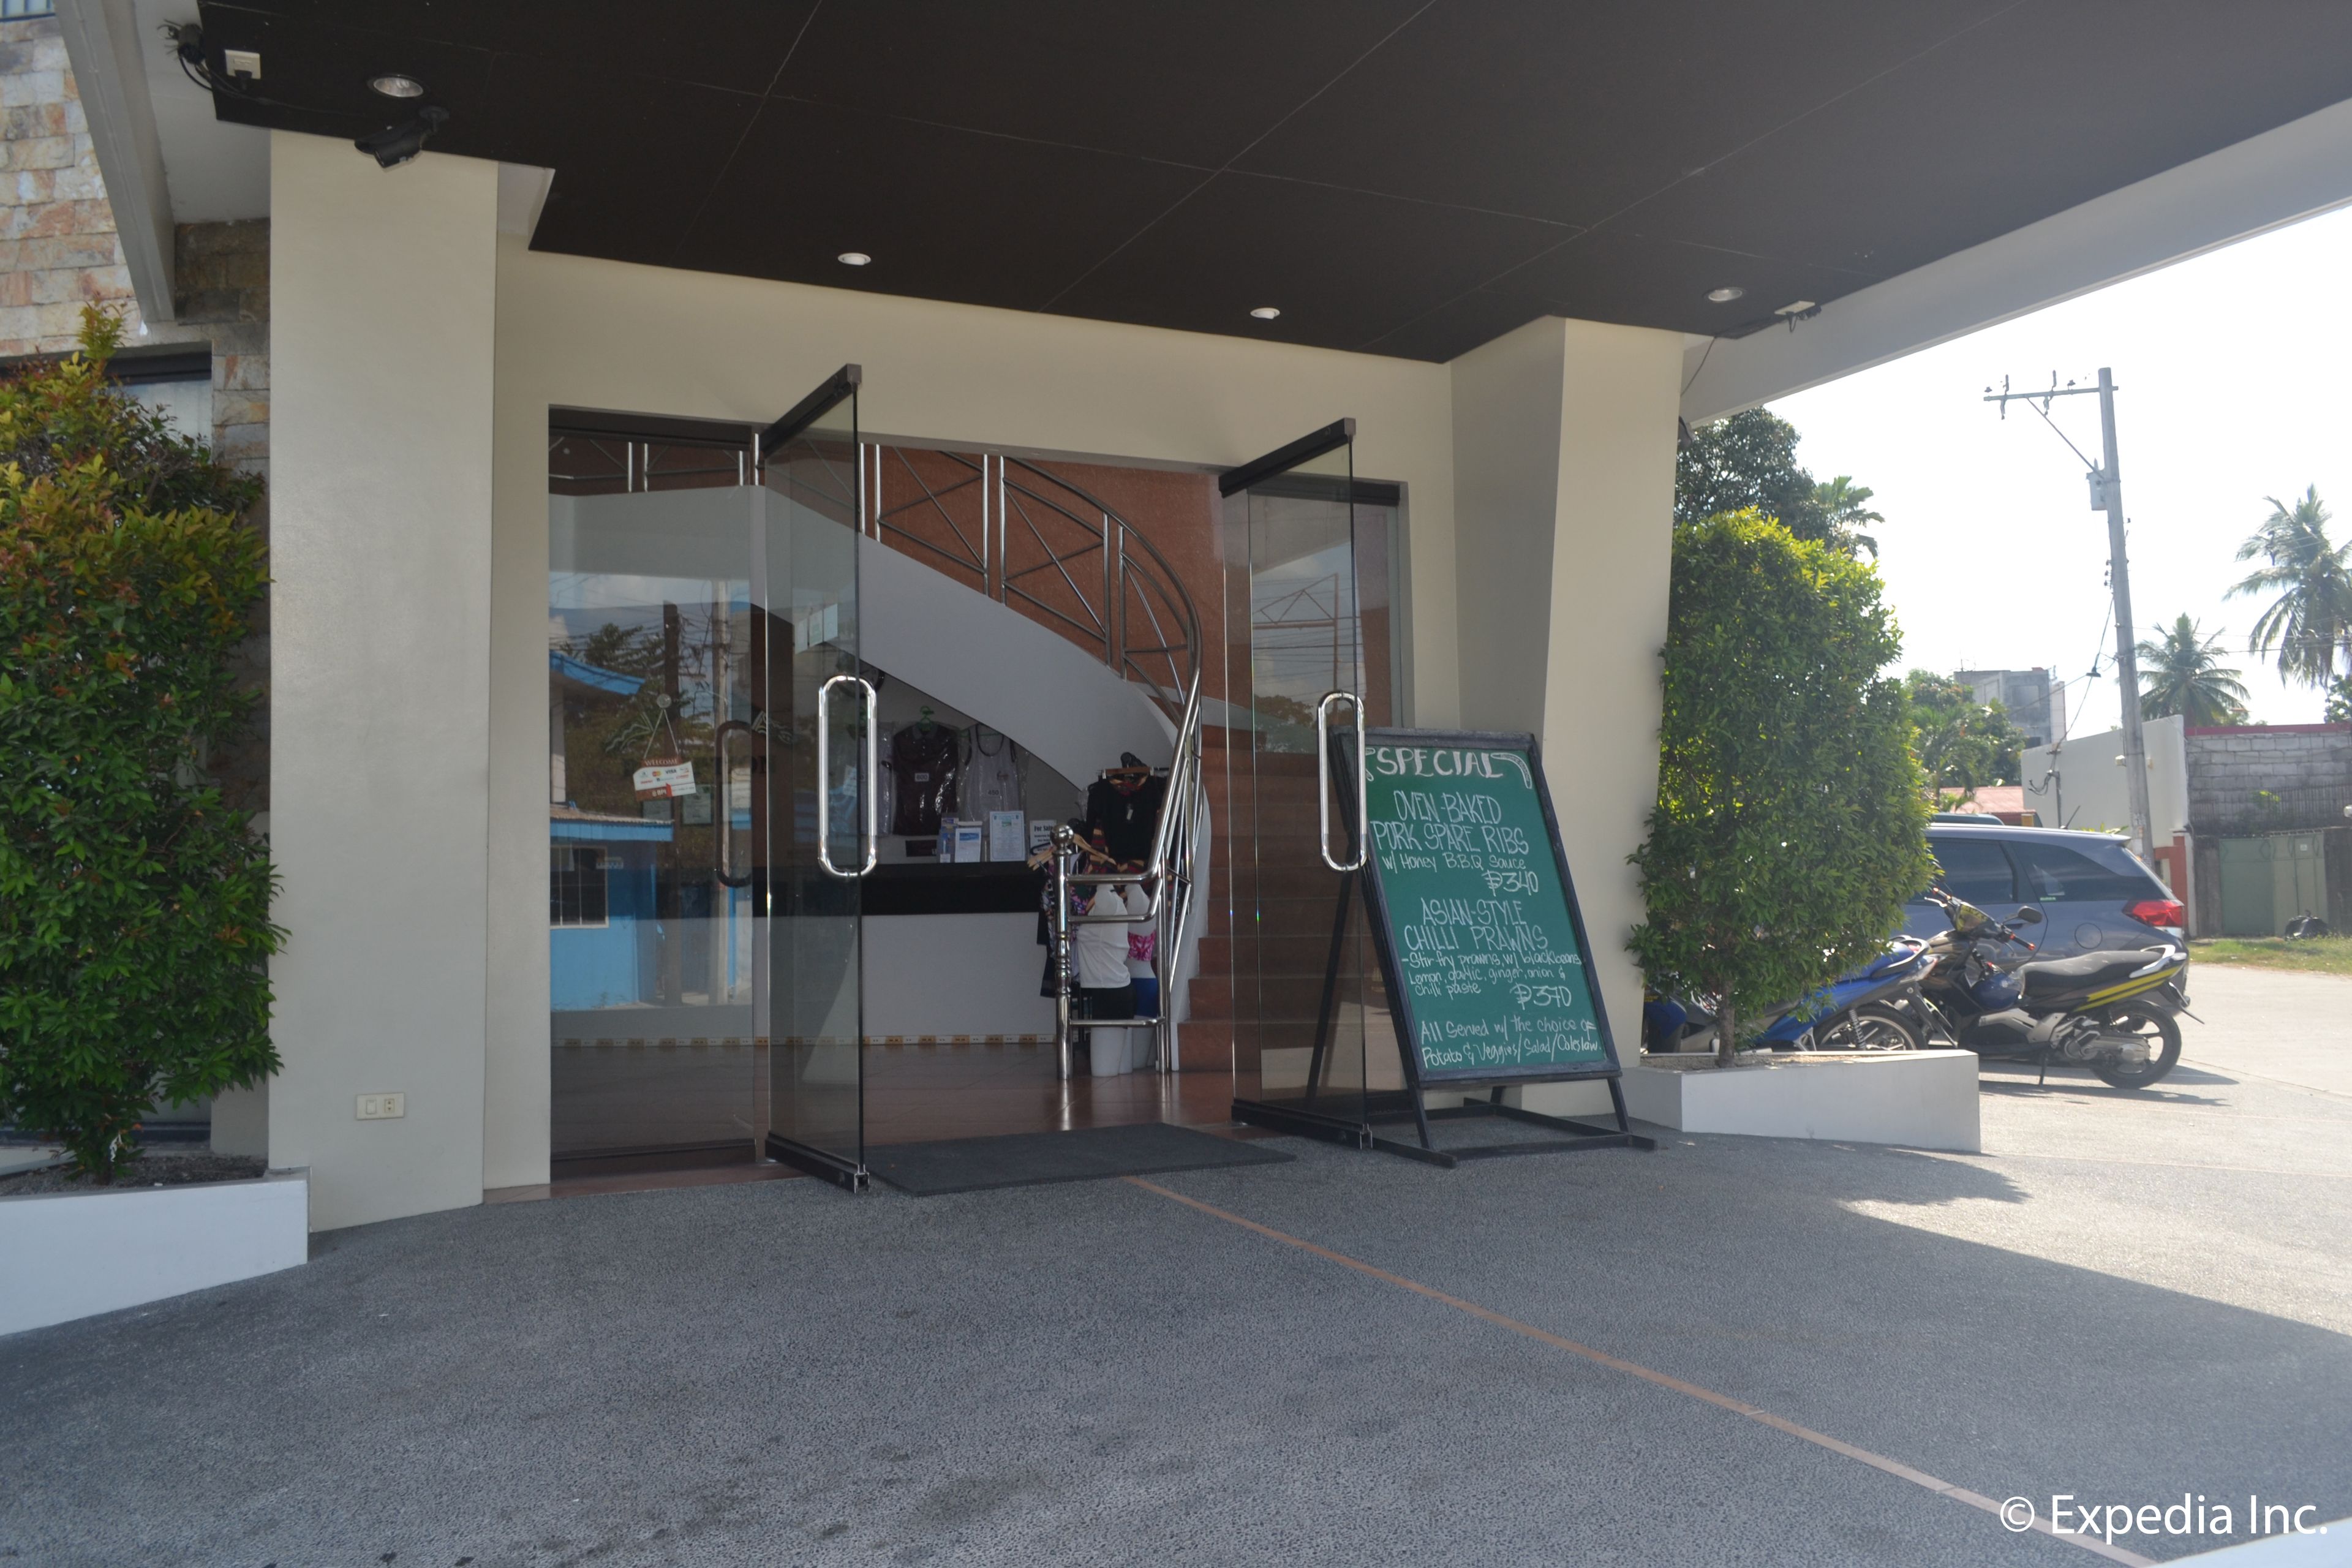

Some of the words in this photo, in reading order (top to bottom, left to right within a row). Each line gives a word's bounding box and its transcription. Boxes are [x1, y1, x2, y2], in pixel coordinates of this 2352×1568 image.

[1377, 747, 1503, 778] SPECIAL
[1370, 821, 1422, 851] PORK
[1424, 823, 1481, 853] SPARE
[1481, 826, 1529, 855] RIBS
[1400, 853, 1438, 873] Honey
[1404, 925, 1459, 951] CHILLI
[1471, 925, 1548, 952] PRAWNS
[1446, 981, 1481, 1000] paste
[1422, 1020, 1443, 1044] All
[1510, 1014, 1532, 1031] the
[1537, 1016, 1577, 1032] choice
[1422, 1047, 1462, 1069] Potato
